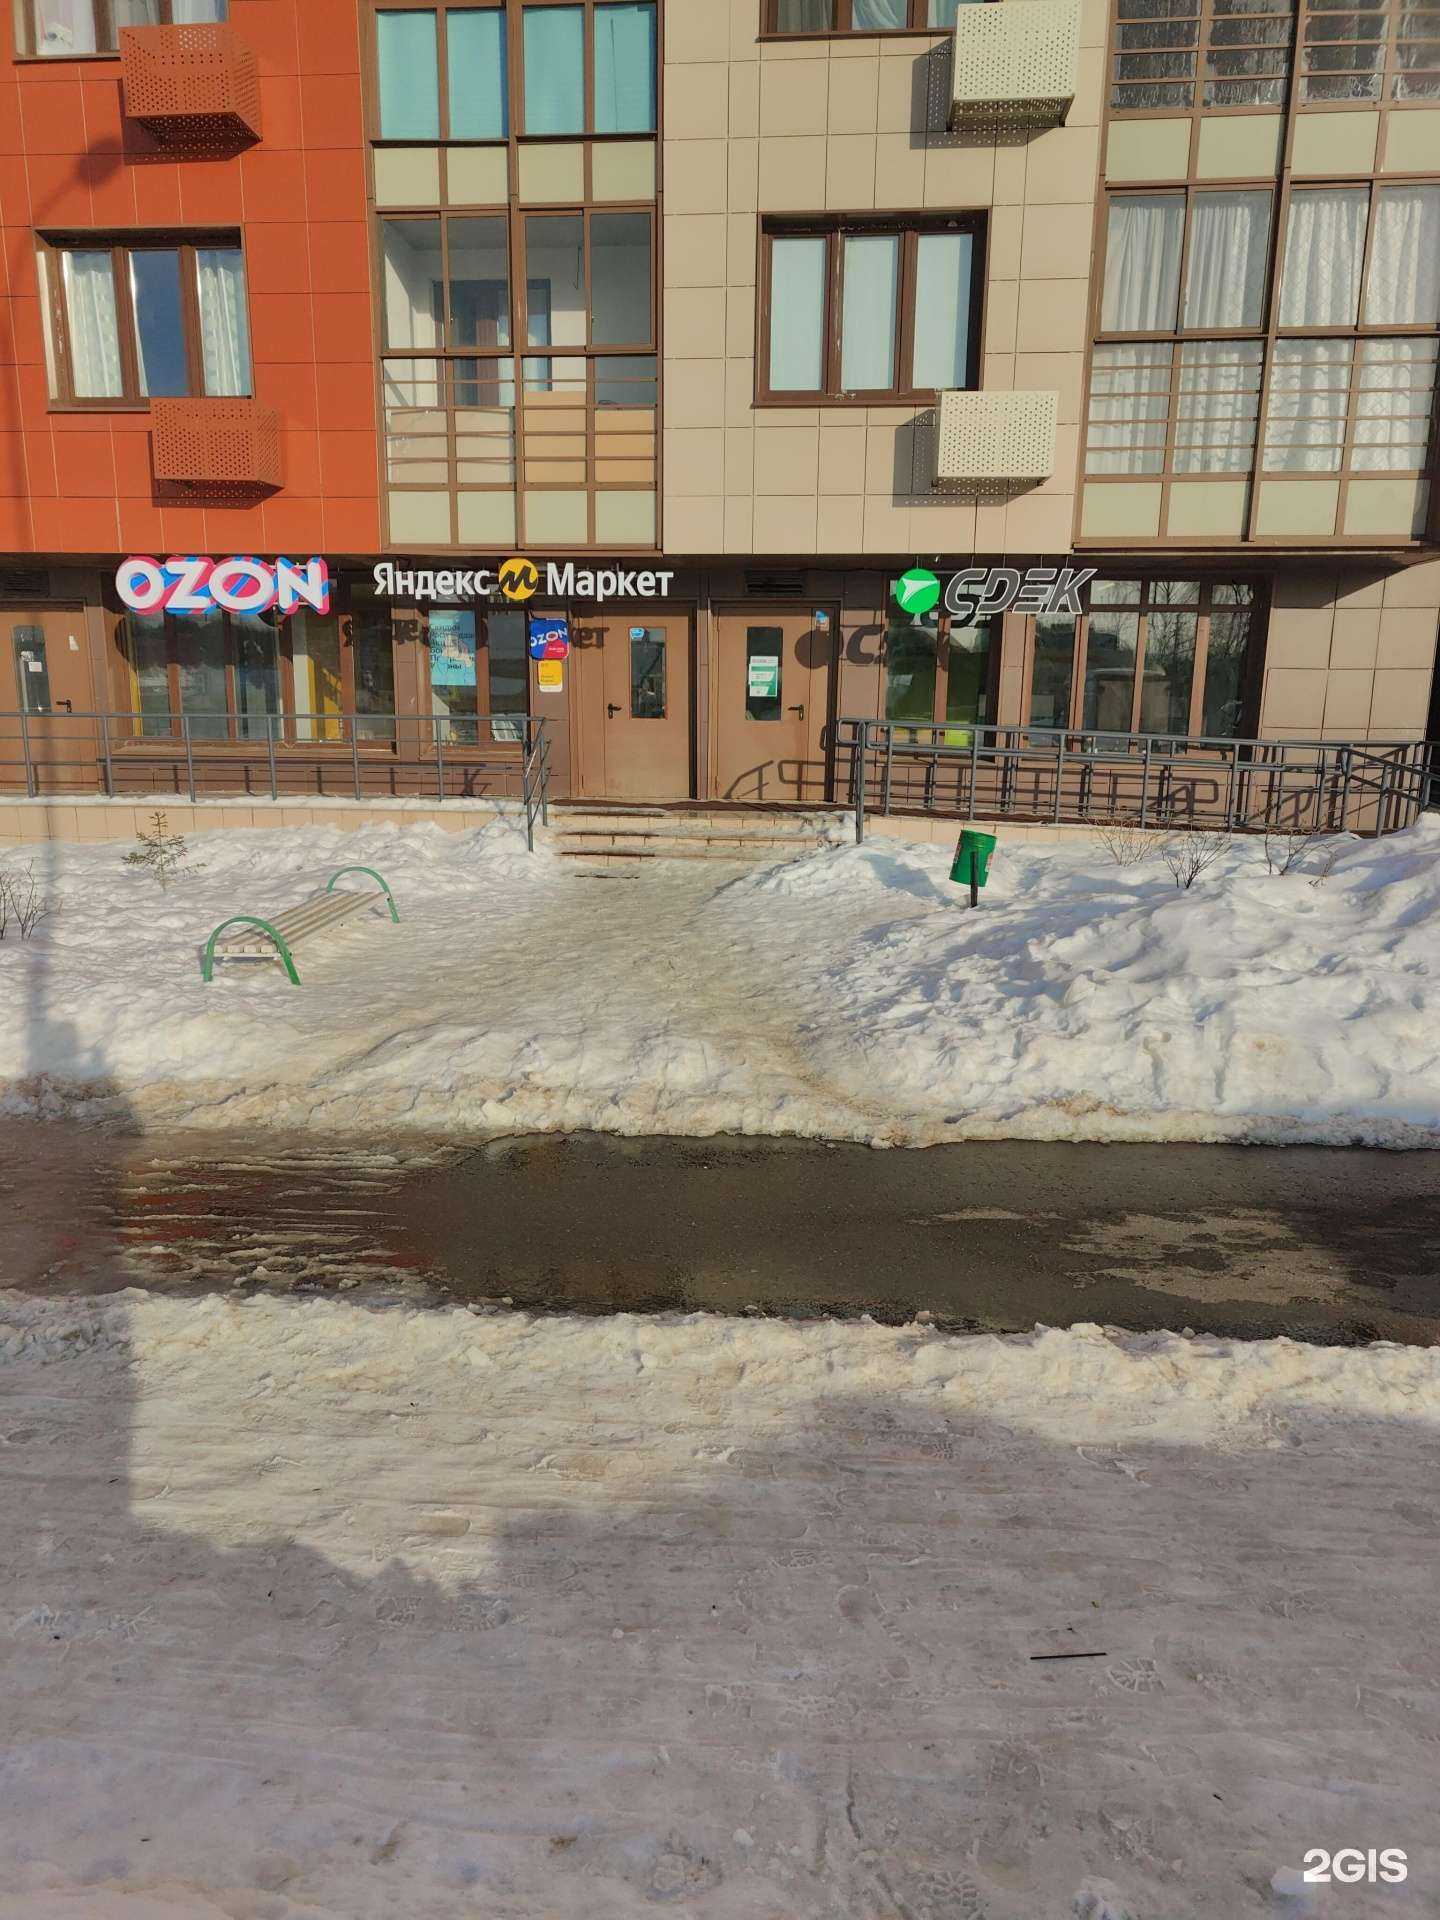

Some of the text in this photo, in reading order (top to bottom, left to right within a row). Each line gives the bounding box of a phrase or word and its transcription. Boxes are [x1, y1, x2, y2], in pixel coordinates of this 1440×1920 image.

[115, 556, 328, 614] OZON
[373, 562, 490, 600] Яндекс
[547, 562, 674, 602] Маркет
[944, 568, 1098, 614] CDEK
[530, 627, 567, 647] OZON
